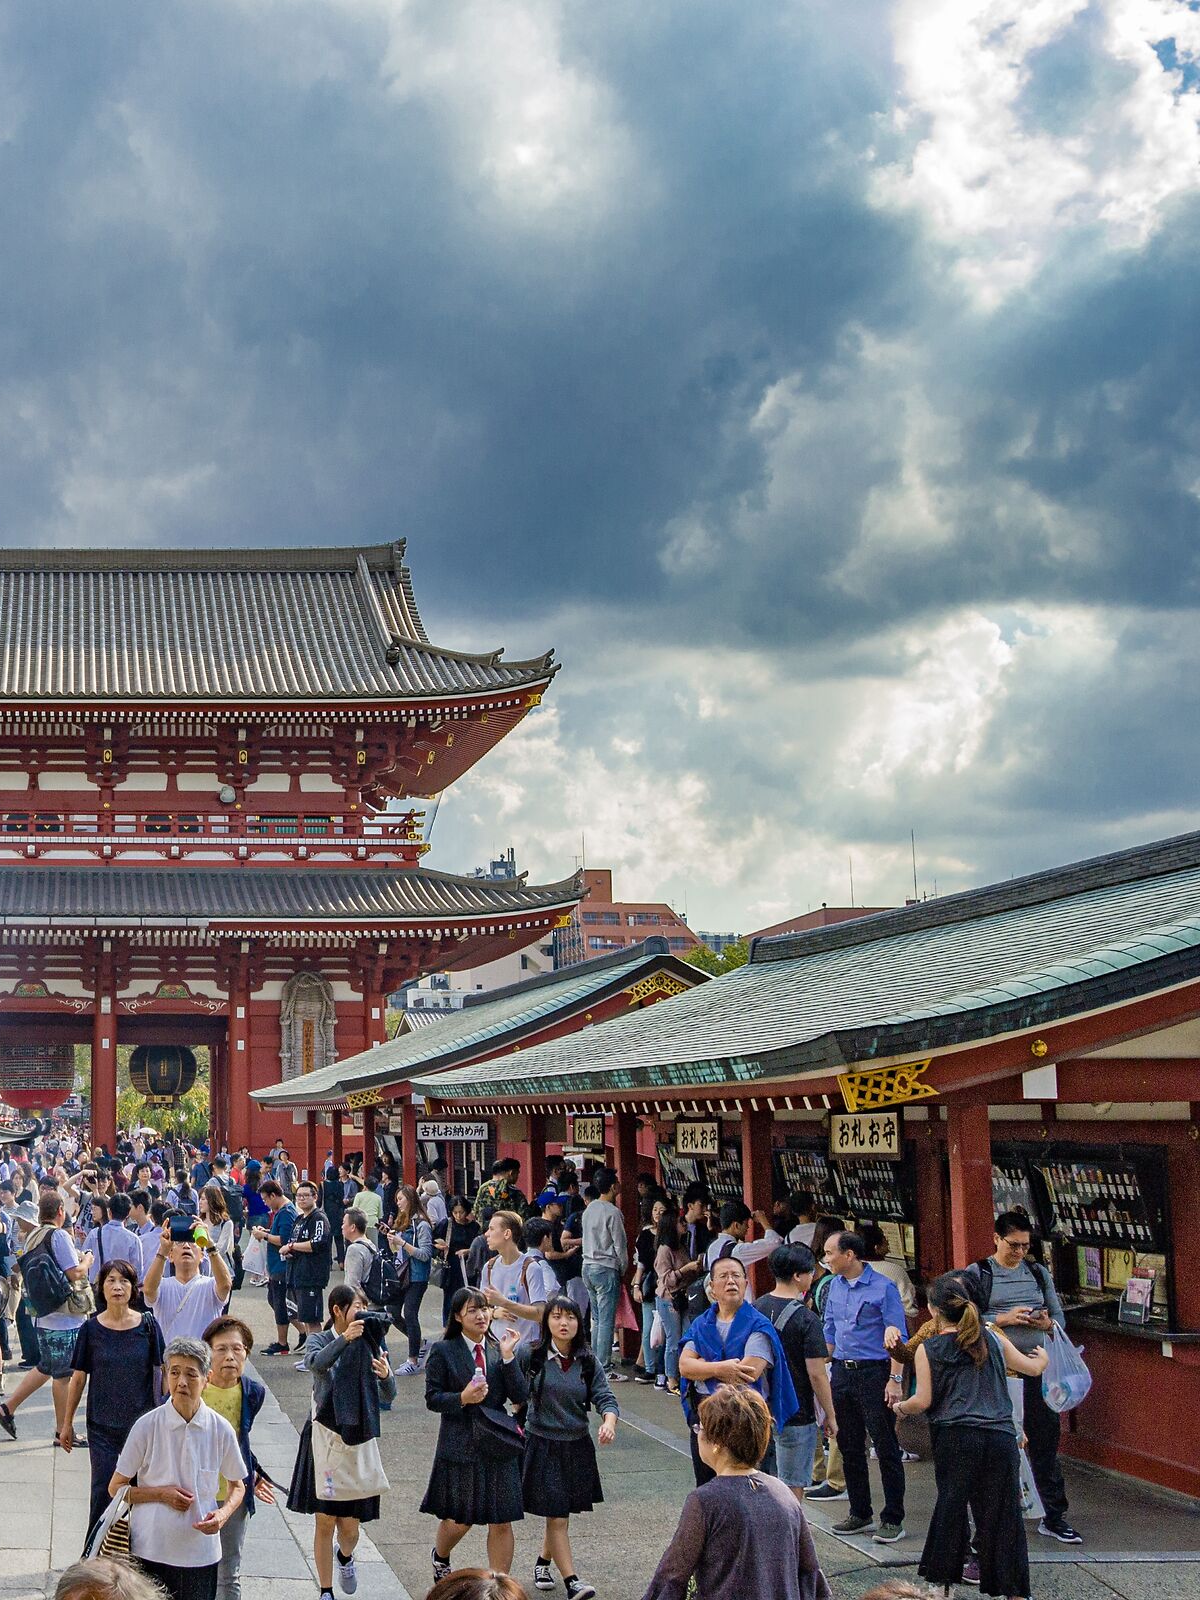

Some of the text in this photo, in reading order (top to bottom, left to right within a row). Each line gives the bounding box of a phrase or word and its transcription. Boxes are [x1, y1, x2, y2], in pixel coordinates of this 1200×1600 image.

[420, 1124, 485, 1137] 古札お納め所
[681, 1126, 717, 1150] お札お守
[839, 1116, 896, 1149] お札お守
